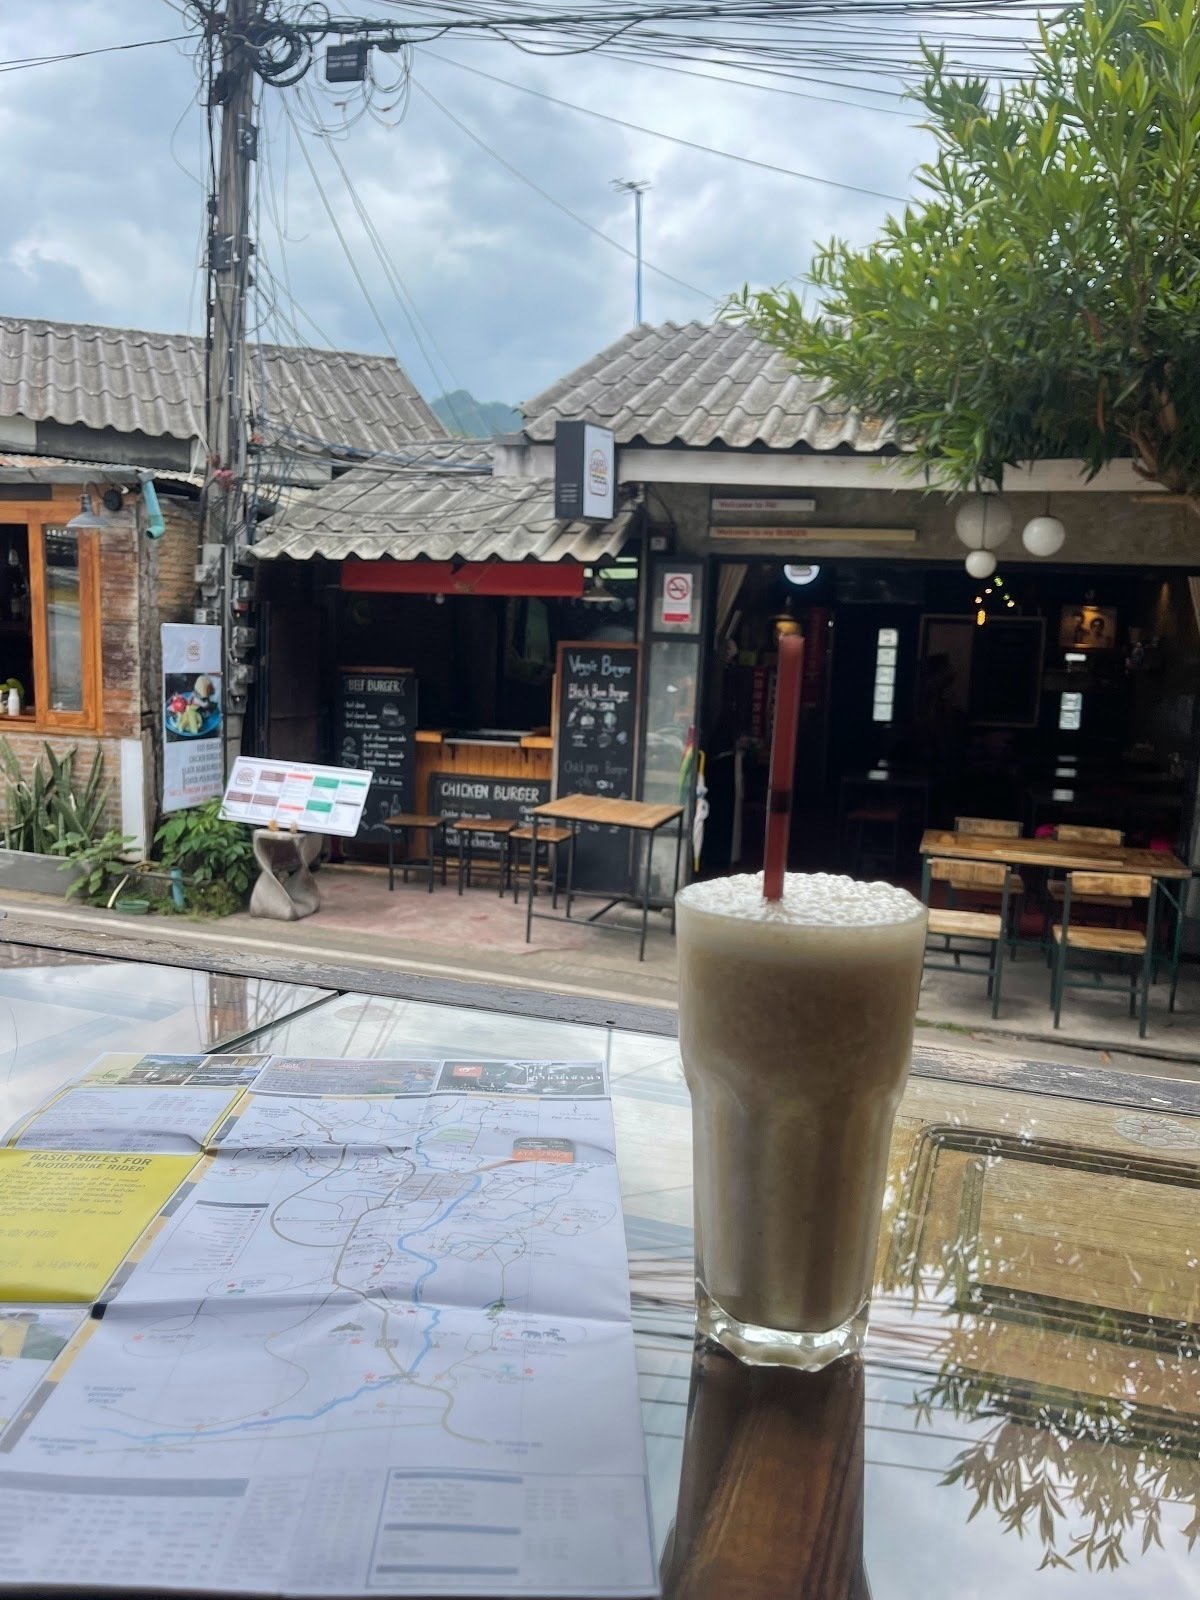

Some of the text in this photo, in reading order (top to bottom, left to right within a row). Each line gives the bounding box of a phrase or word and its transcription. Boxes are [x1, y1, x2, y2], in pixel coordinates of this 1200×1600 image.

[367, 680, 400, 693] BURGER
[441, 782, 541, 803] CHICKEN BURGER
[30, 1153, 153, 1166] BASIC RULES FOR
[34, 1161, 105, 1170] MOTORBIKE
[106, 1164, 145, 1173] RIDER
